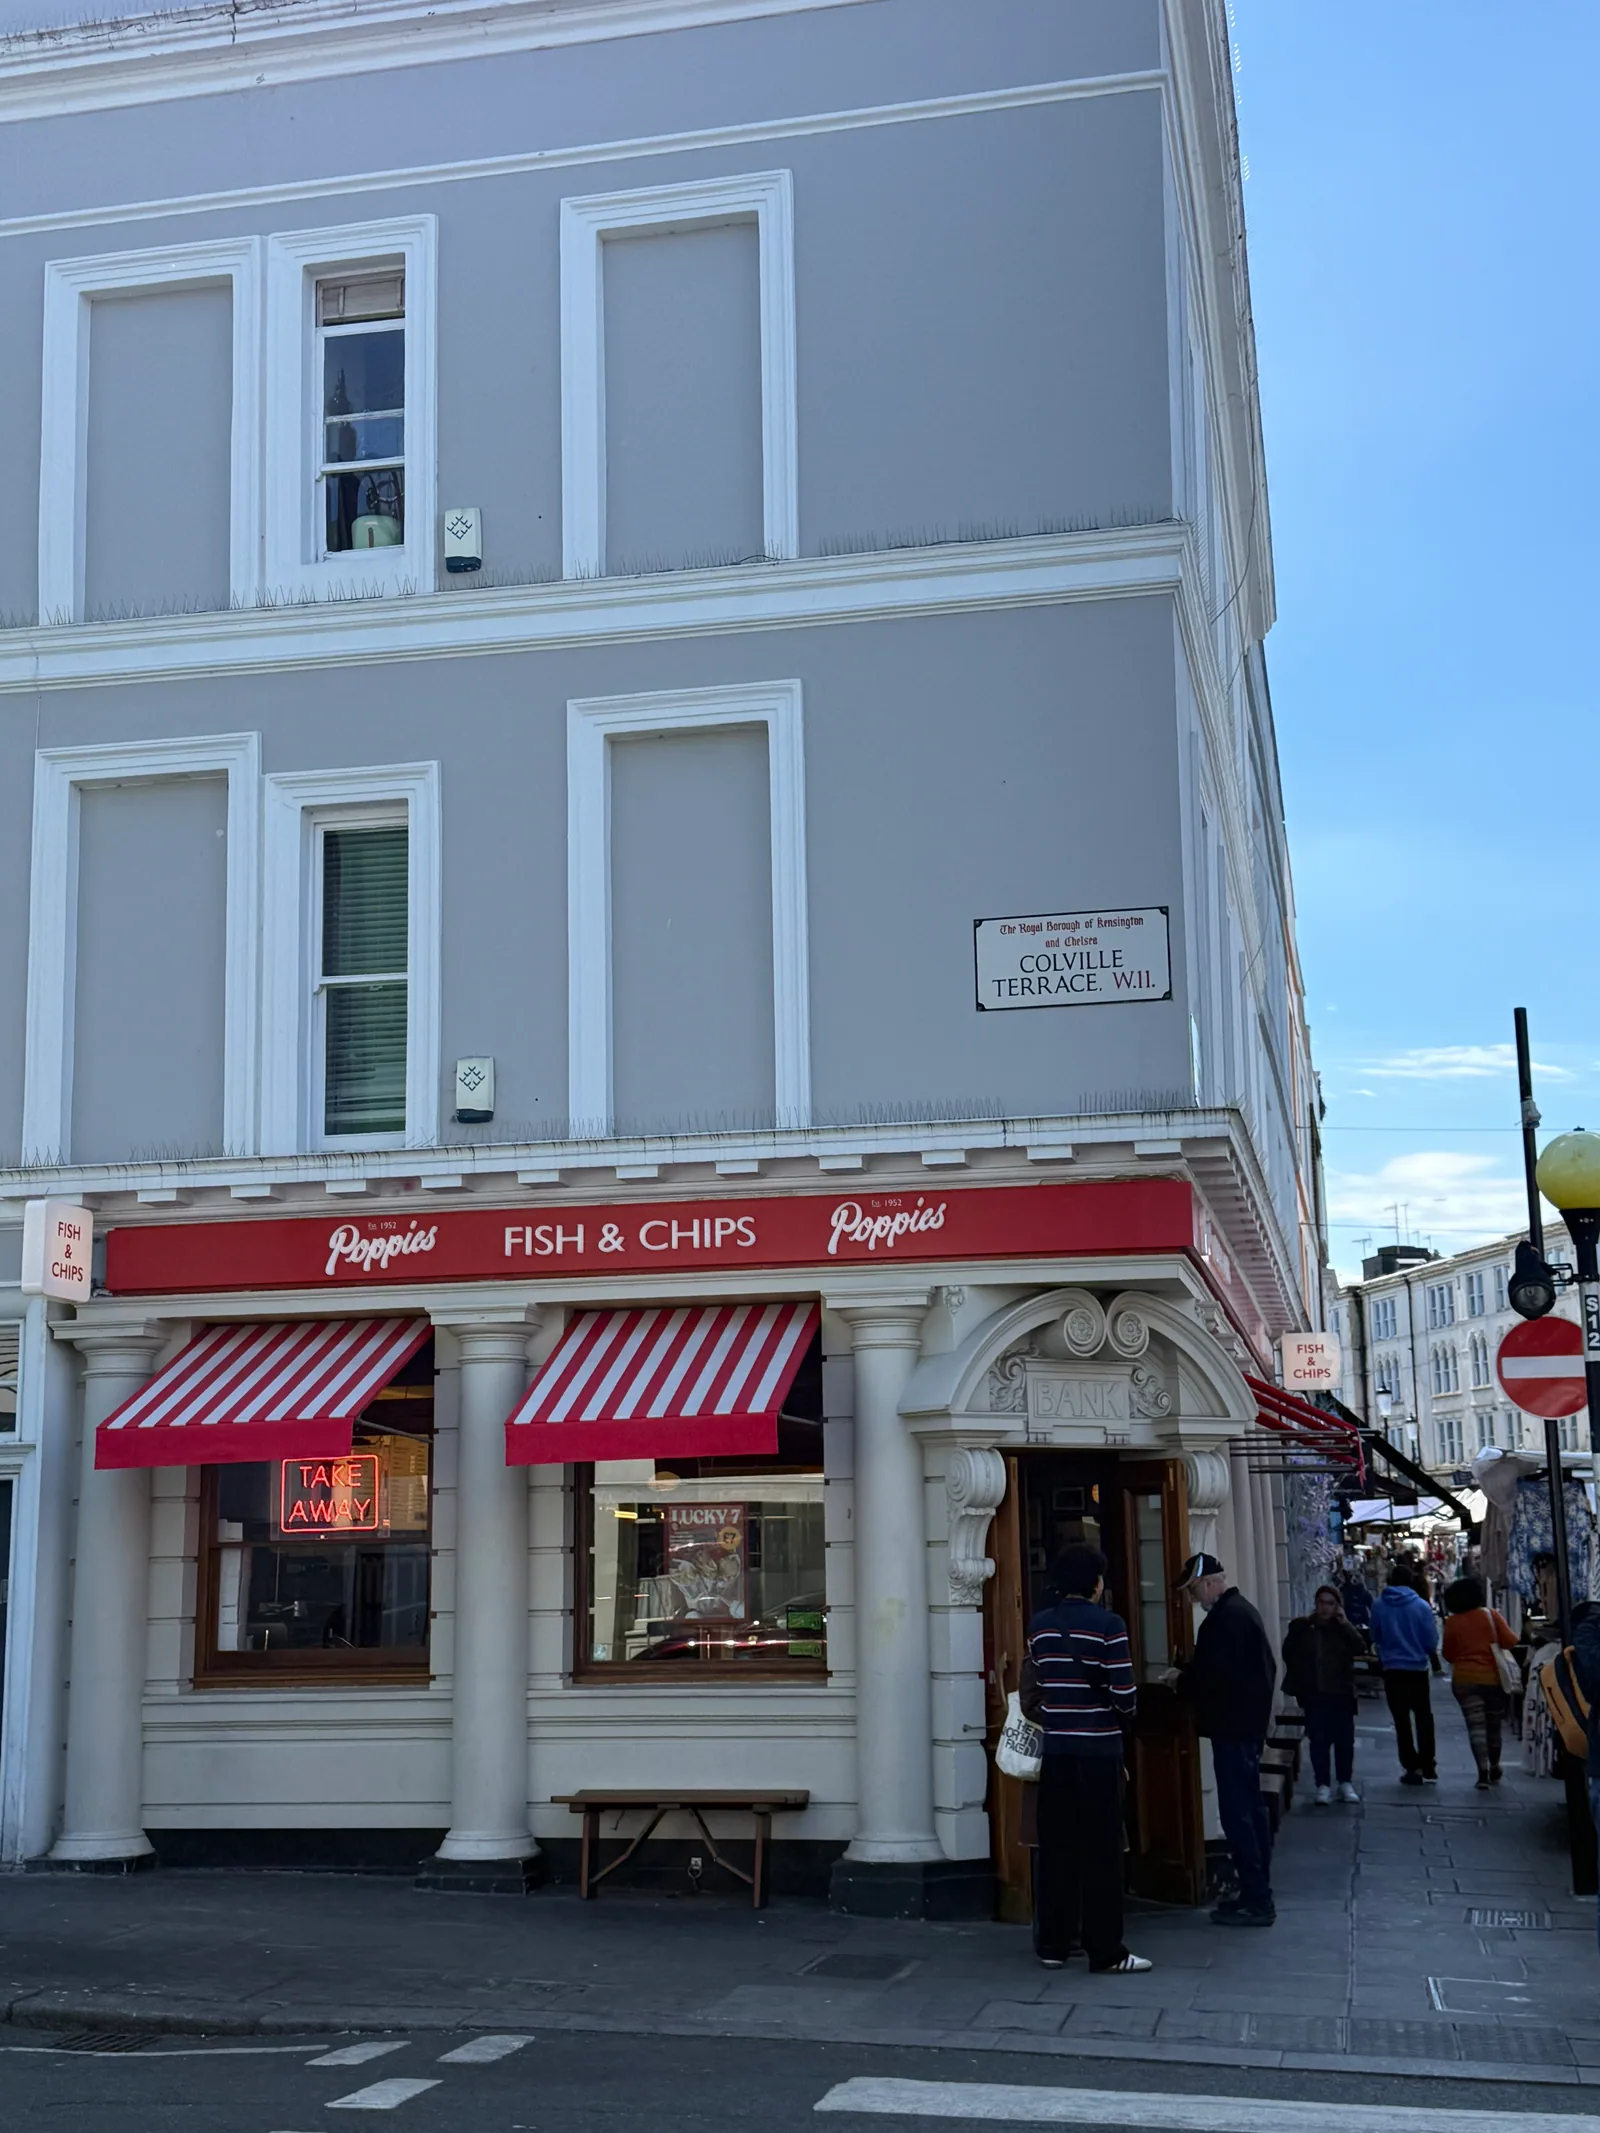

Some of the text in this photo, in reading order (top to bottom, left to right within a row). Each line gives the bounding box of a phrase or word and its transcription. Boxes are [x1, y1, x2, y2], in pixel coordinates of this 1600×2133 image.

[1000, 916, 1144, 935] The Royal Borough of Kensington
[1045, 936, 1098, 948] and Chelsea
[1019, 949, 1124, 974] COLVILLE
[884, 1199, 902, 1207] 1952
[57, 1221, 81, 1241] FISH
[380, 1221, 397, 1230] 1952
[827, 1196, 947, 1255] Poppies
[504, 1216, 757, 1257] FISH & CHIPS
[64, 1244, 73, 1259] &
[325, 1220, 438, 1276] Poppies
[51, 1261, 84, 1283] CHIPS
[1297, 1344, 1324, 1354] FISH
[1307, 1356, 1316, 1366] &
[1293, 1368, 1331, 1379] CHIPS
[1036, 1381, 1122, 1418] BANK
[299, 1464, 363, 1489] TAKE
[288, 1498, 371, 1523] AWAY
[672, 1509, 741, 1524] LUCKY 7
[1017, 1718, 1034, 1736] THE
